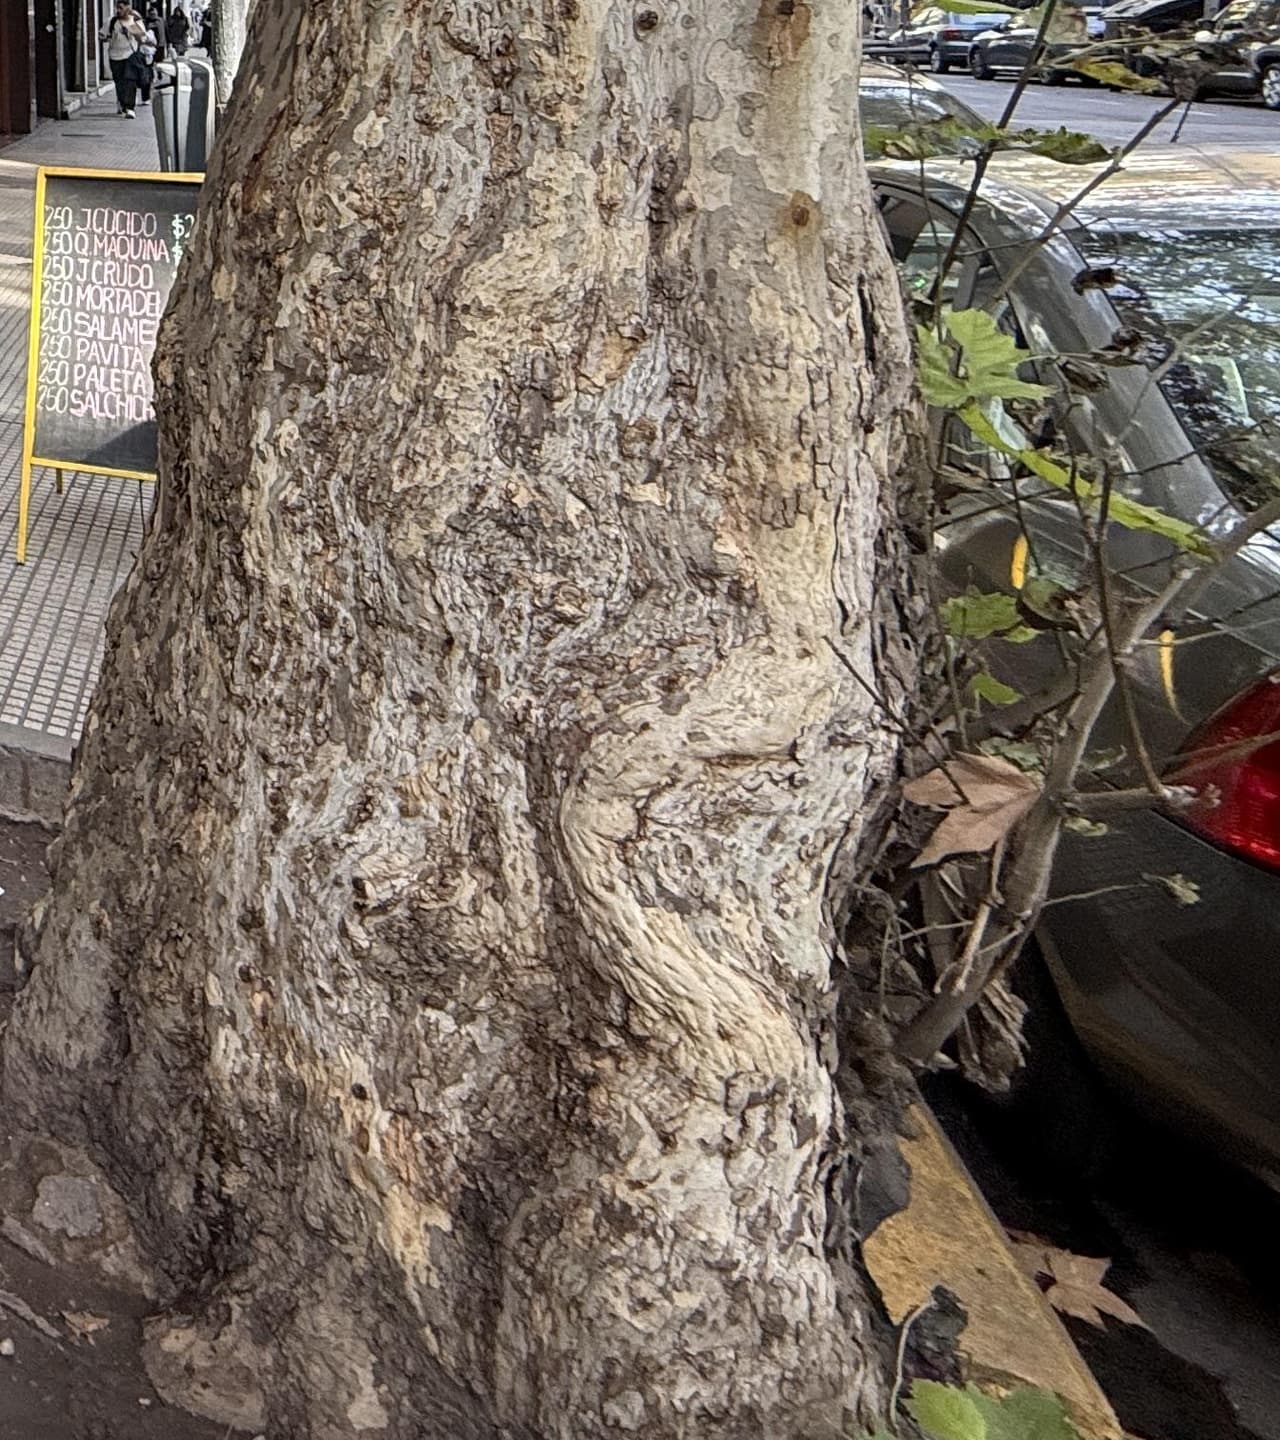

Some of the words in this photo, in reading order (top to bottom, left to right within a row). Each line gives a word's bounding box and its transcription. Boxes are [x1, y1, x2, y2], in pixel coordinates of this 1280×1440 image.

[44, 205, 72, 229] 250
[43, 231, 72, 254] 250
[43, 256, 73, 280] 250
[42, 281, 72, 306] 250
[40, 308, 72, 334] 250
[74, 312, 156, 345] SALAME
[40, 333, 71, 358] 250
[76, 338, 146, 371] PAVITA
[38, 360, 69, 385] 250
[73, 364, 147, 395] PALETA
[37, 386, 69, 414] 250
